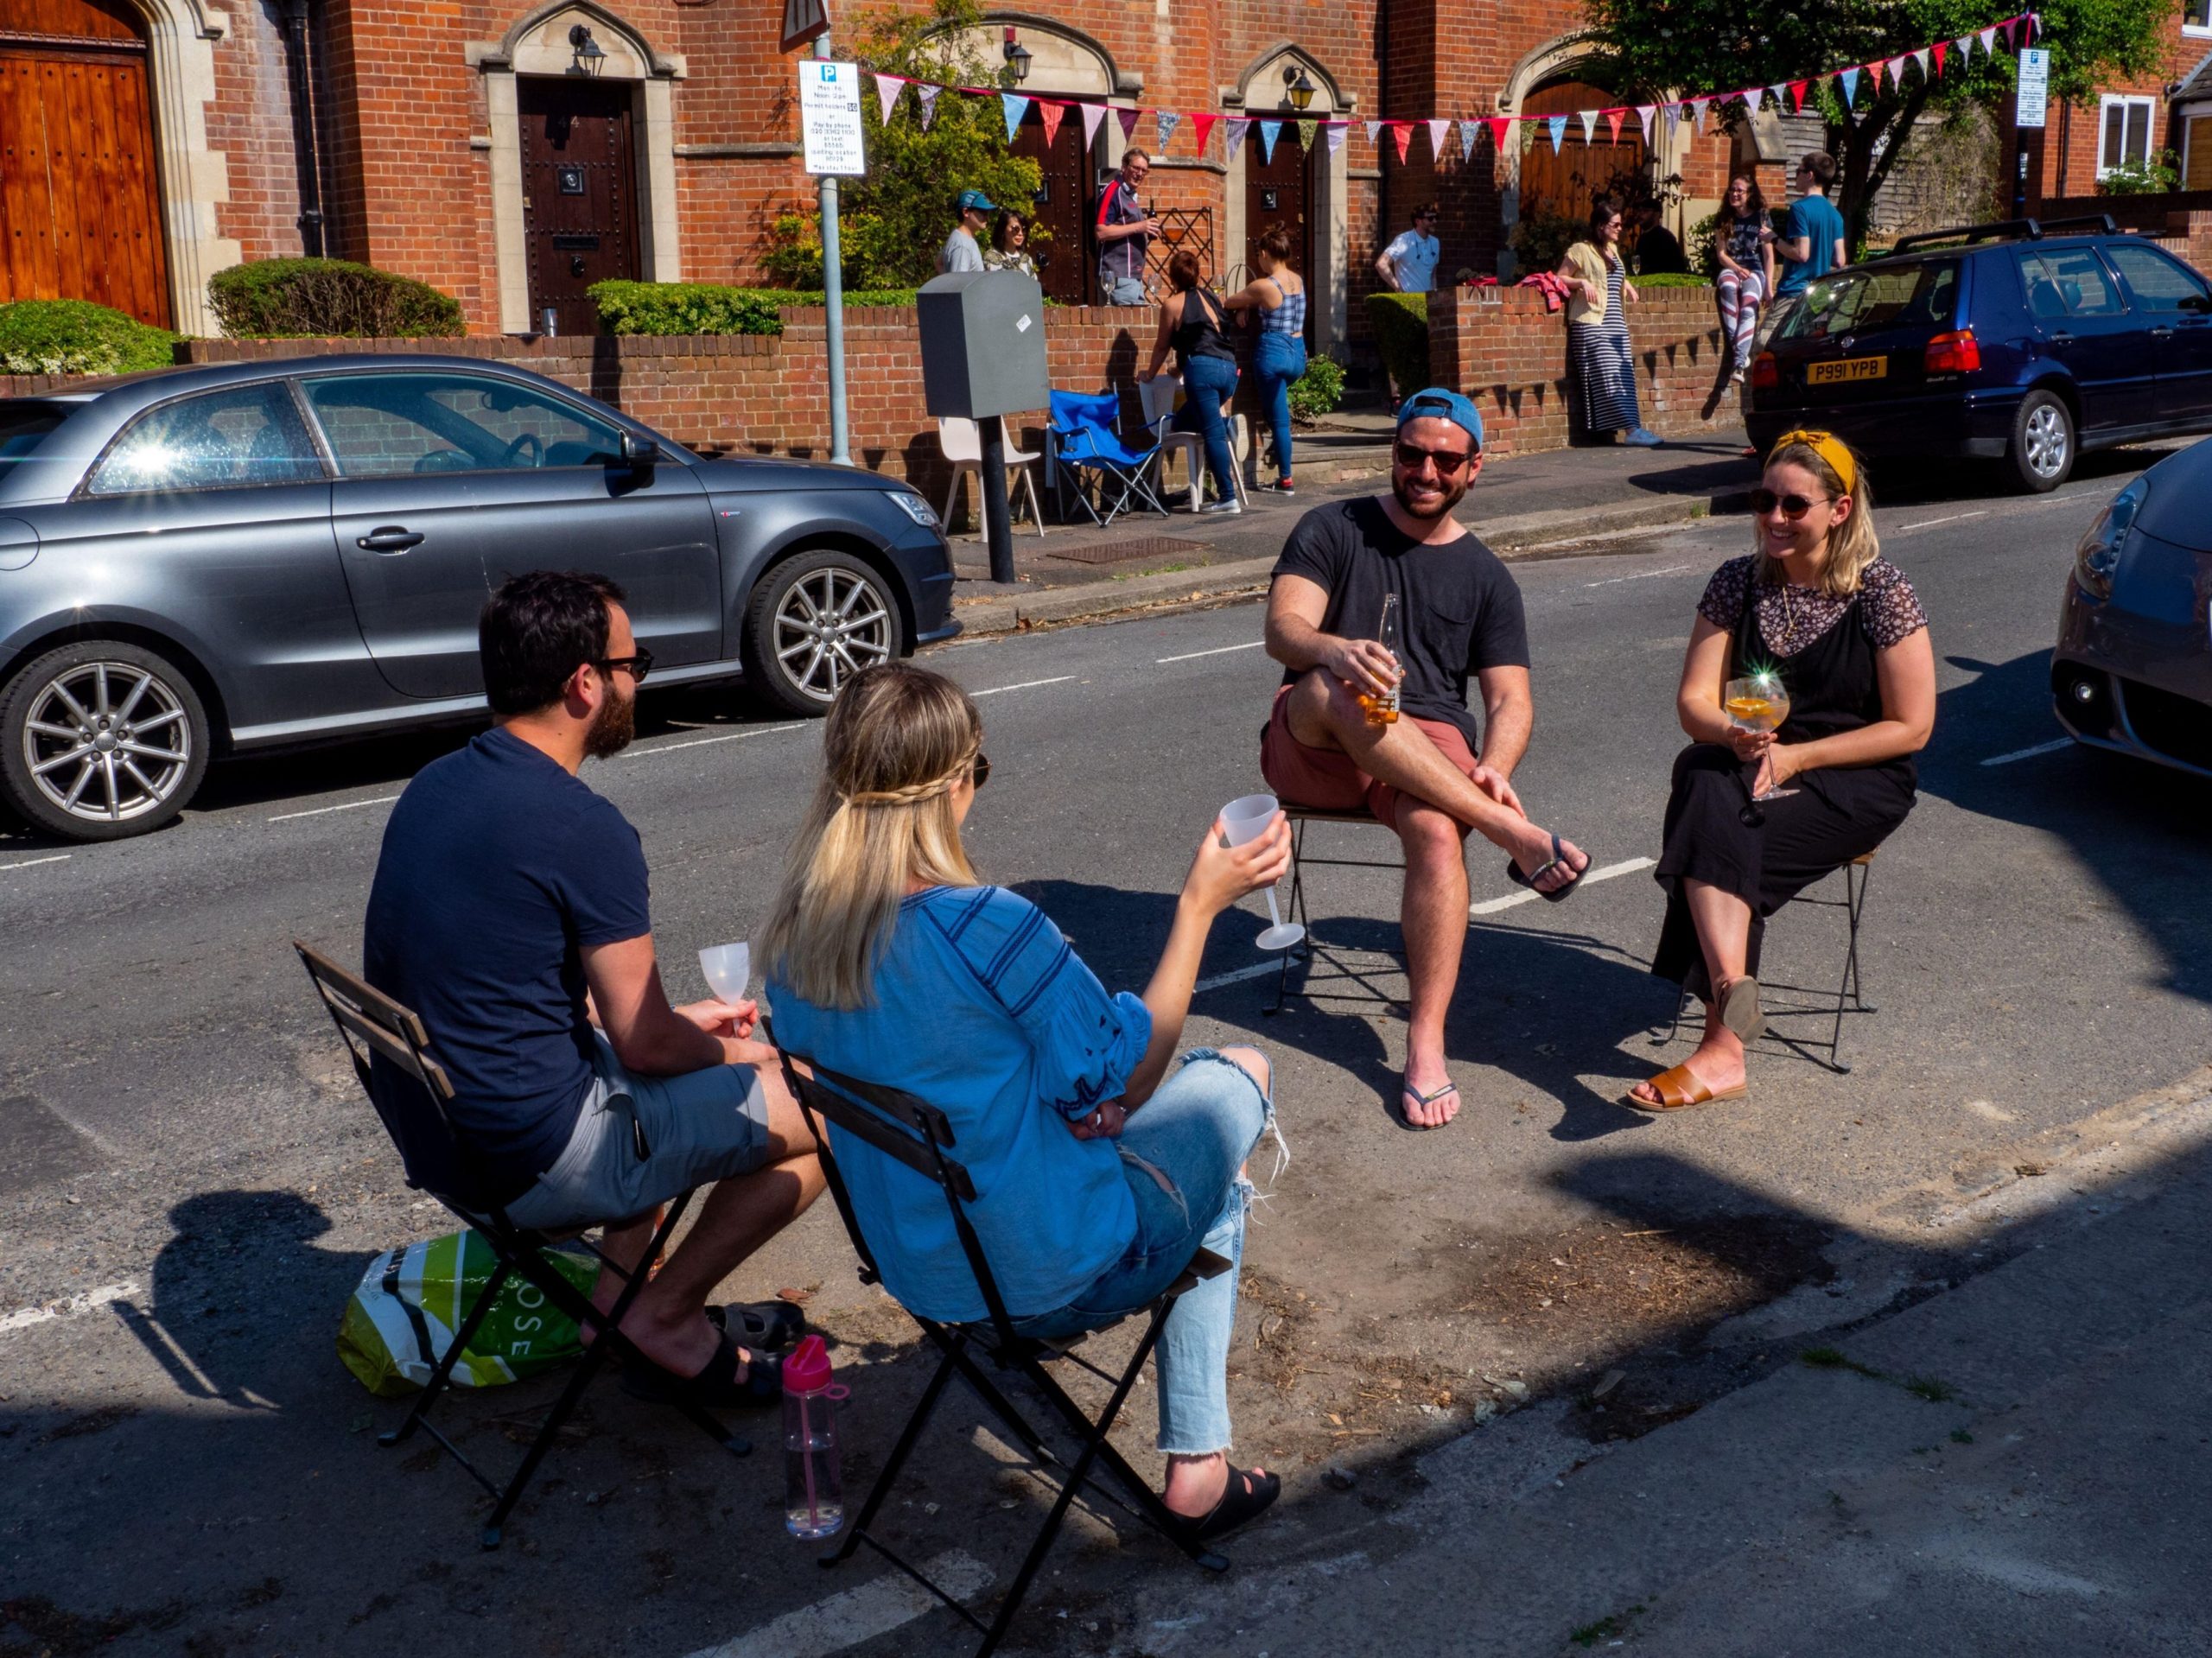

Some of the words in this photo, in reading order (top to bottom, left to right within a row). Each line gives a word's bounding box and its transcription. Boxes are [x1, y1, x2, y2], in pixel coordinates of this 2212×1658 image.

[823, 65, 836, 82] P
[1816, 364, 1847, 381] P991
[1851, 360, 1878, 378] YPB
